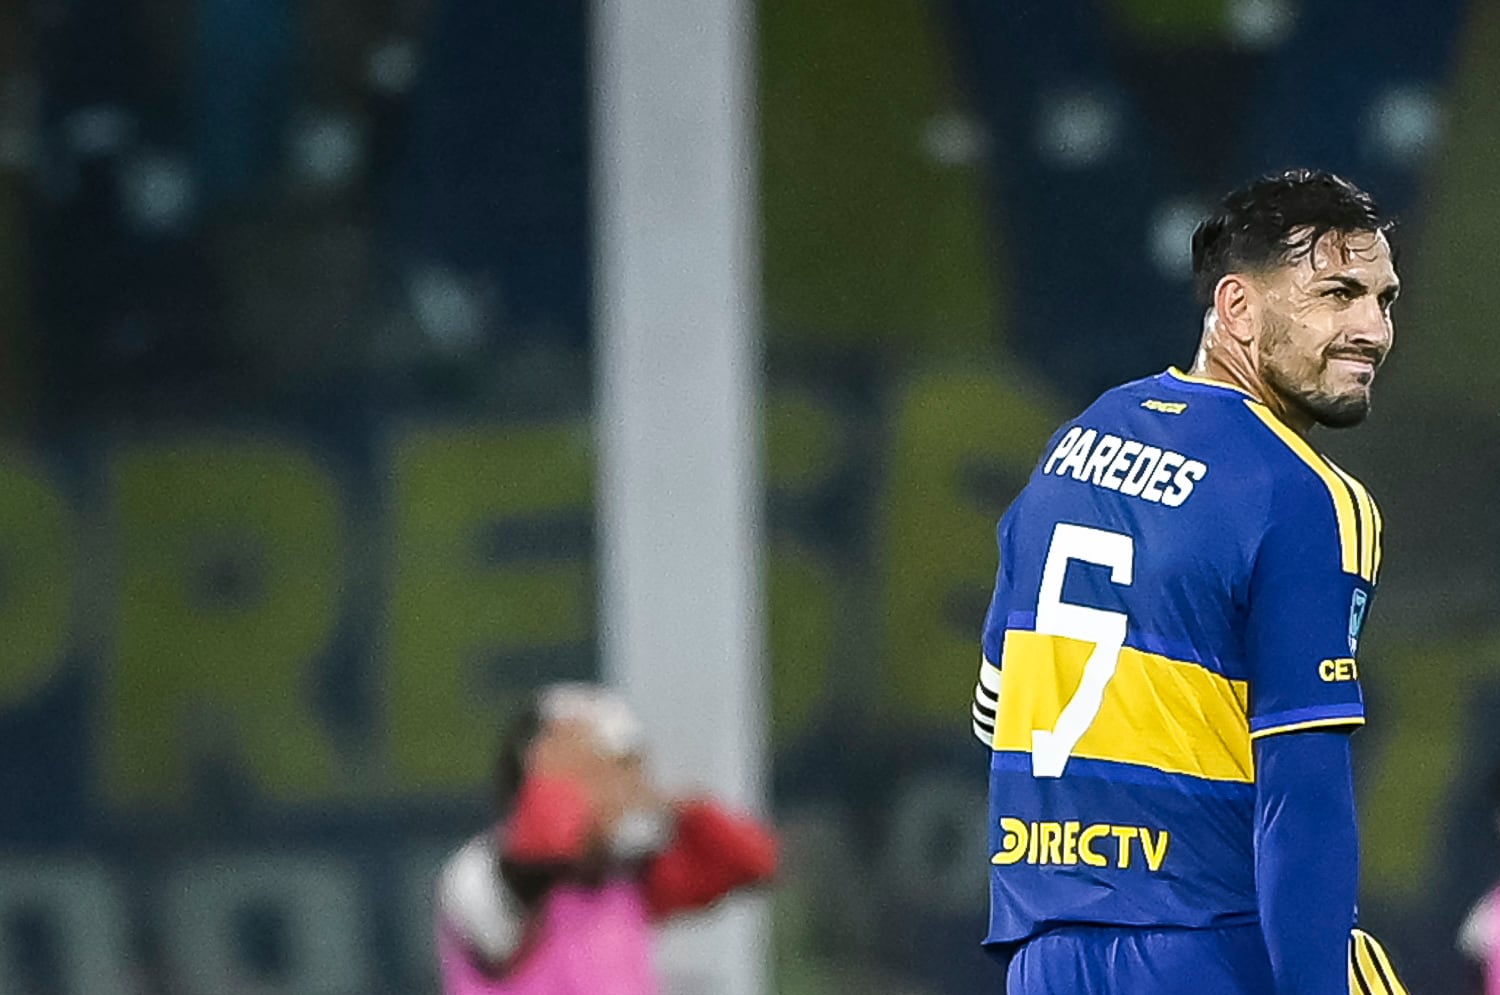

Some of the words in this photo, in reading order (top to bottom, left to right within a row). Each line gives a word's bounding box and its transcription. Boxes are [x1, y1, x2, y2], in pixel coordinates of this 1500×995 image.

[1044, 426, 1206, 506] PAREDES
[1032, 523, 1133, 777] 5
[992, 818, 1167, 870] DIRECTV
